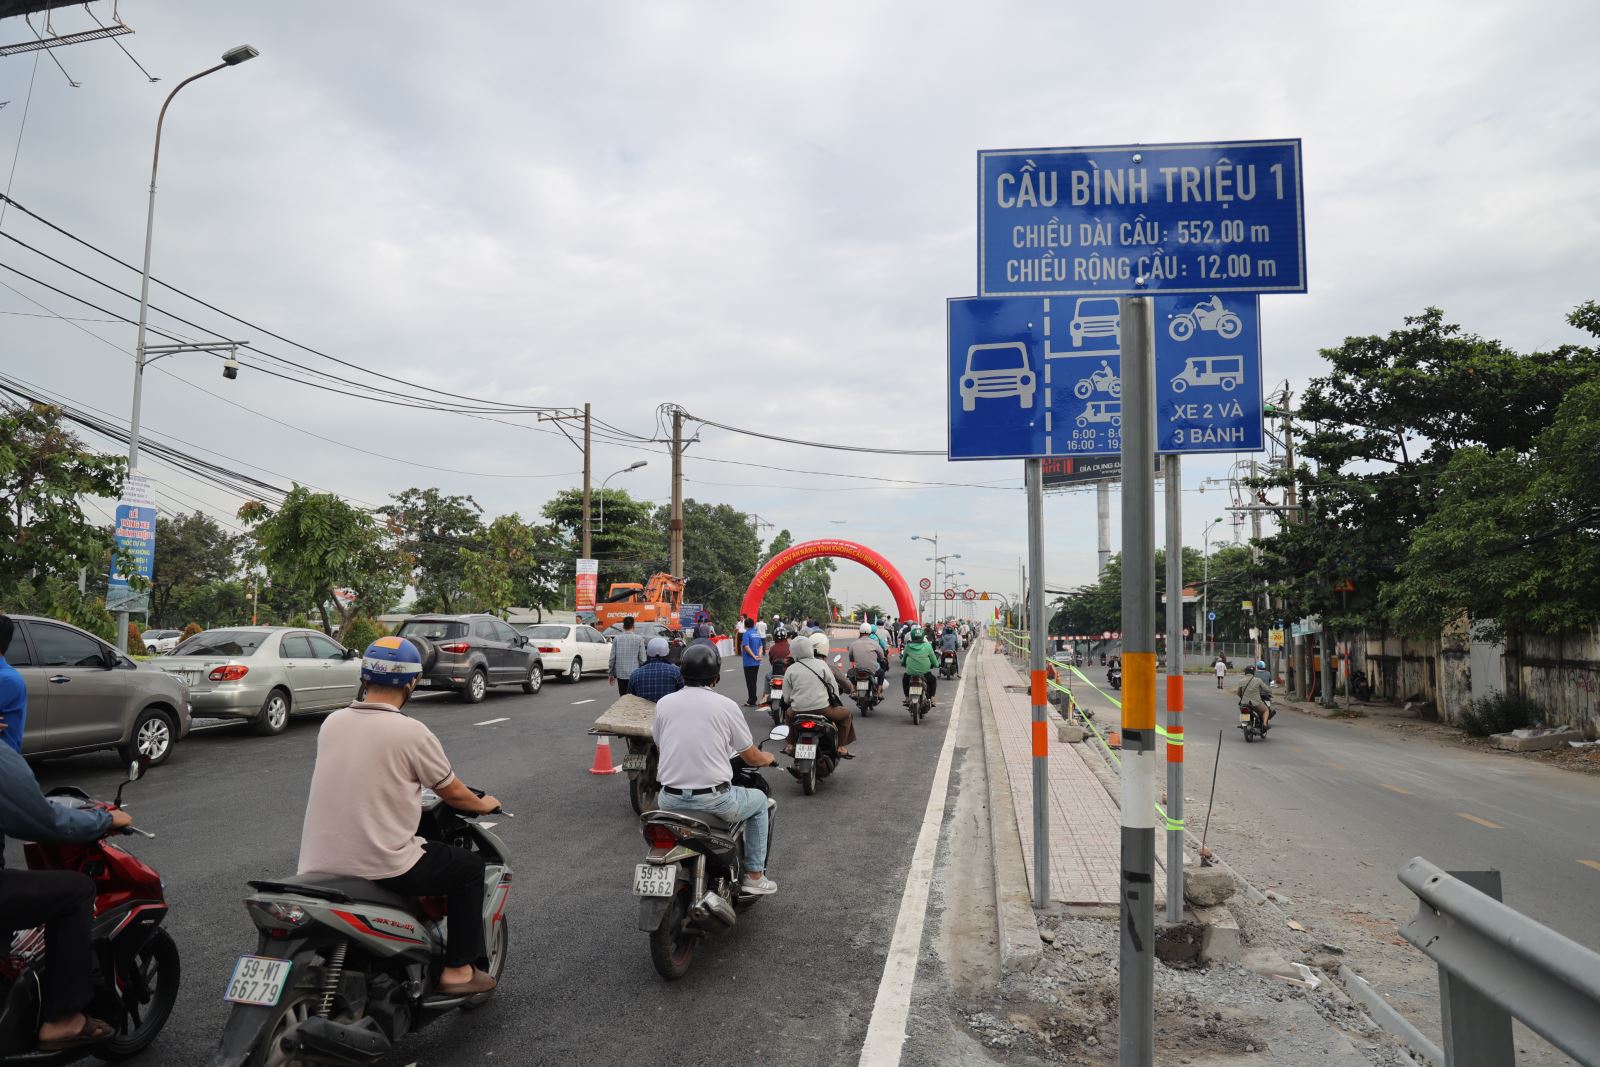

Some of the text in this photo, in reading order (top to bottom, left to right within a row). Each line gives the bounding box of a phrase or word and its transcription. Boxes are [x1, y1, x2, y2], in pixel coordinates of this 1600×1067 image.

[997, 157, 1285, 209] CẦU BÌNH TRIỆU 1
[1013, 216, 1072, 248] CHIỀU
[1080, 217, 1112, 247] DÀI
[1177, 219, 1244, 245] 552,00
[1251, 224, 1270, 243] m
[1006, 250, 1066, 283] CHIỀU
[1074, 252, 1131, 286] RỘNG
[1197, 254, 1251, 281] 12,00
[1258, 259, 1277, 277] m
[1174, 399, 1244, 420] XE 2 VÀ
[1066, 439, 1095, 450] 16:00
[1072, 429, 1096, 439] 6:00
[1174, 424, 1245, 444] 3 BÁNH
[640, 866, 669, 880] 59-S1
[635, 880, 673, 895] 455.62
[242, 959, 280, 981] 59-N1
[229, 979, 278, 1002] 667.79
